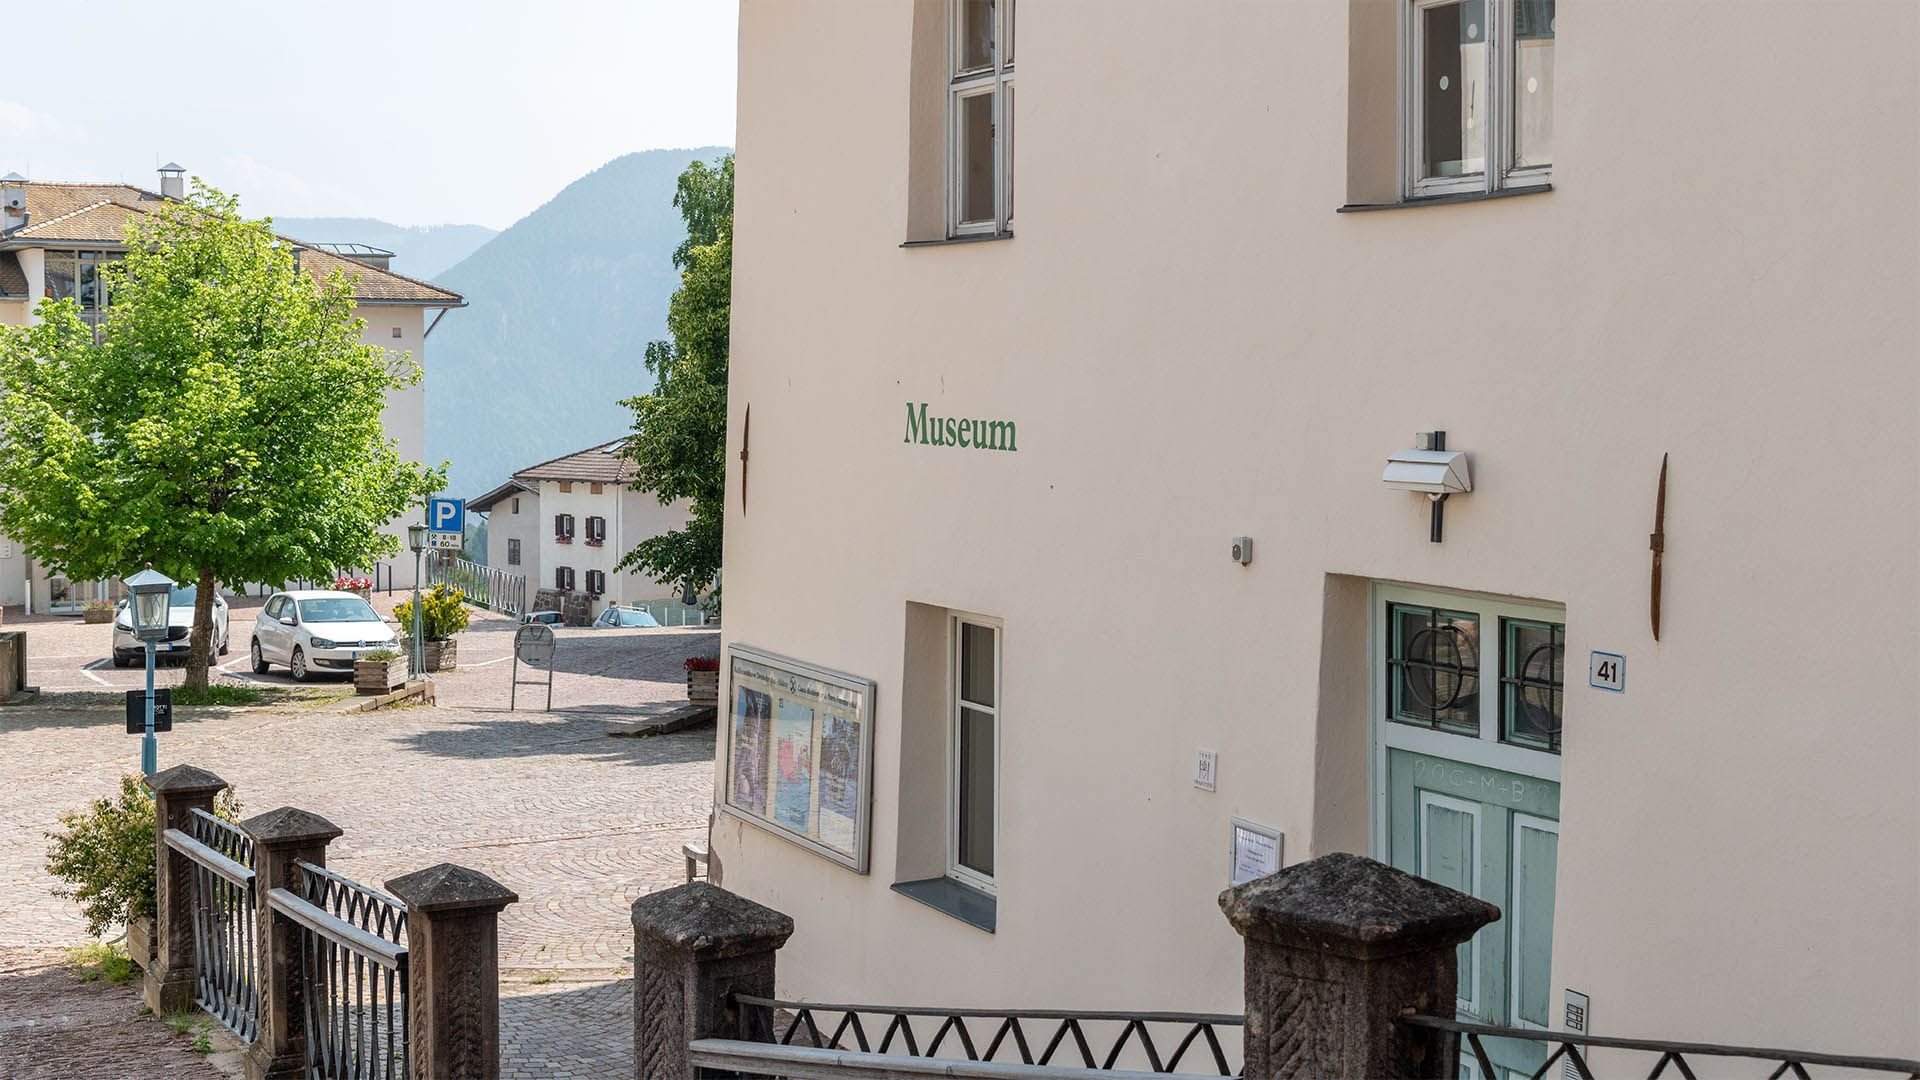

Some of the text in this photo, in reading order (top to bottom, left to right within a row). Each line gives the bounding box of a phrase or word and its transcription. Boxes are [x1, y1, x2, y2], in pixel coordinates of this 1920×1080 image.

[904, 402, 1017, 452] Museum
[436, 501, 456, 529] P
[440, 540, 450, 548] 60
[1597, 661, 1617, 683] 41
